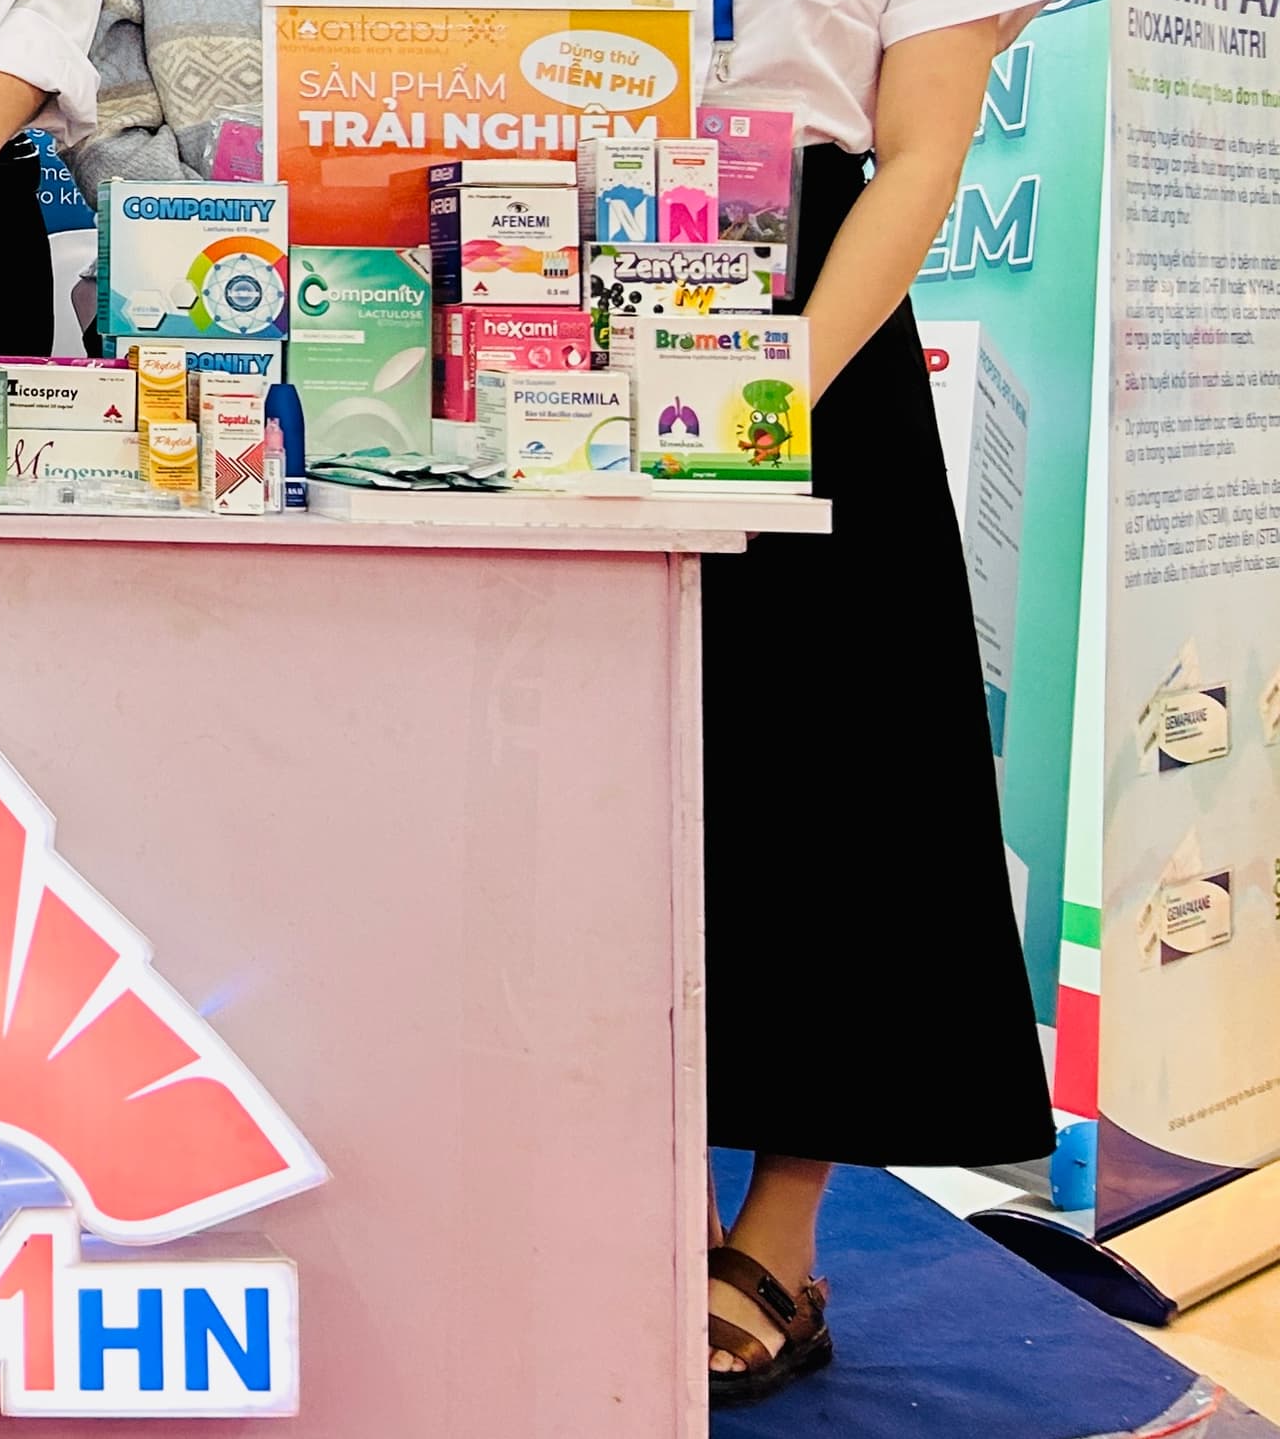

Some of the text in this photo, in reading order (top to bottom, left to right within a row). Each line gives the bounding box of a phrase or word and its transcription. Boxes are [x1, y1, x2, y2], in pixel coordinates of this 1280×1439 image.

[1128, 6, 1268, 60] ENOXAPARIN NATRI
[559, 40, 641, 68] Dùng thử
[298, 62, 507, 102] SẢN PHẨM
[535, 54, 656, 99] MIỄN PHÍ
[298, 96, 426, 149] TRẢI
[122, 195, 277, 223] COMPANITY
[491, 215, 550, 228] AFENEMI
[614, 251, 749, 285] Zentokid
[297, 273, 425, 318] Companity
[358, 310, 424, 320] LACTULOSE
[483, 319, 558, 339] hexami
[655, 328, 789, 352] Brometic 2mg
[764, 347, 791, 361] 10ml
[514, 391, 620, 406] PROGERMILA
